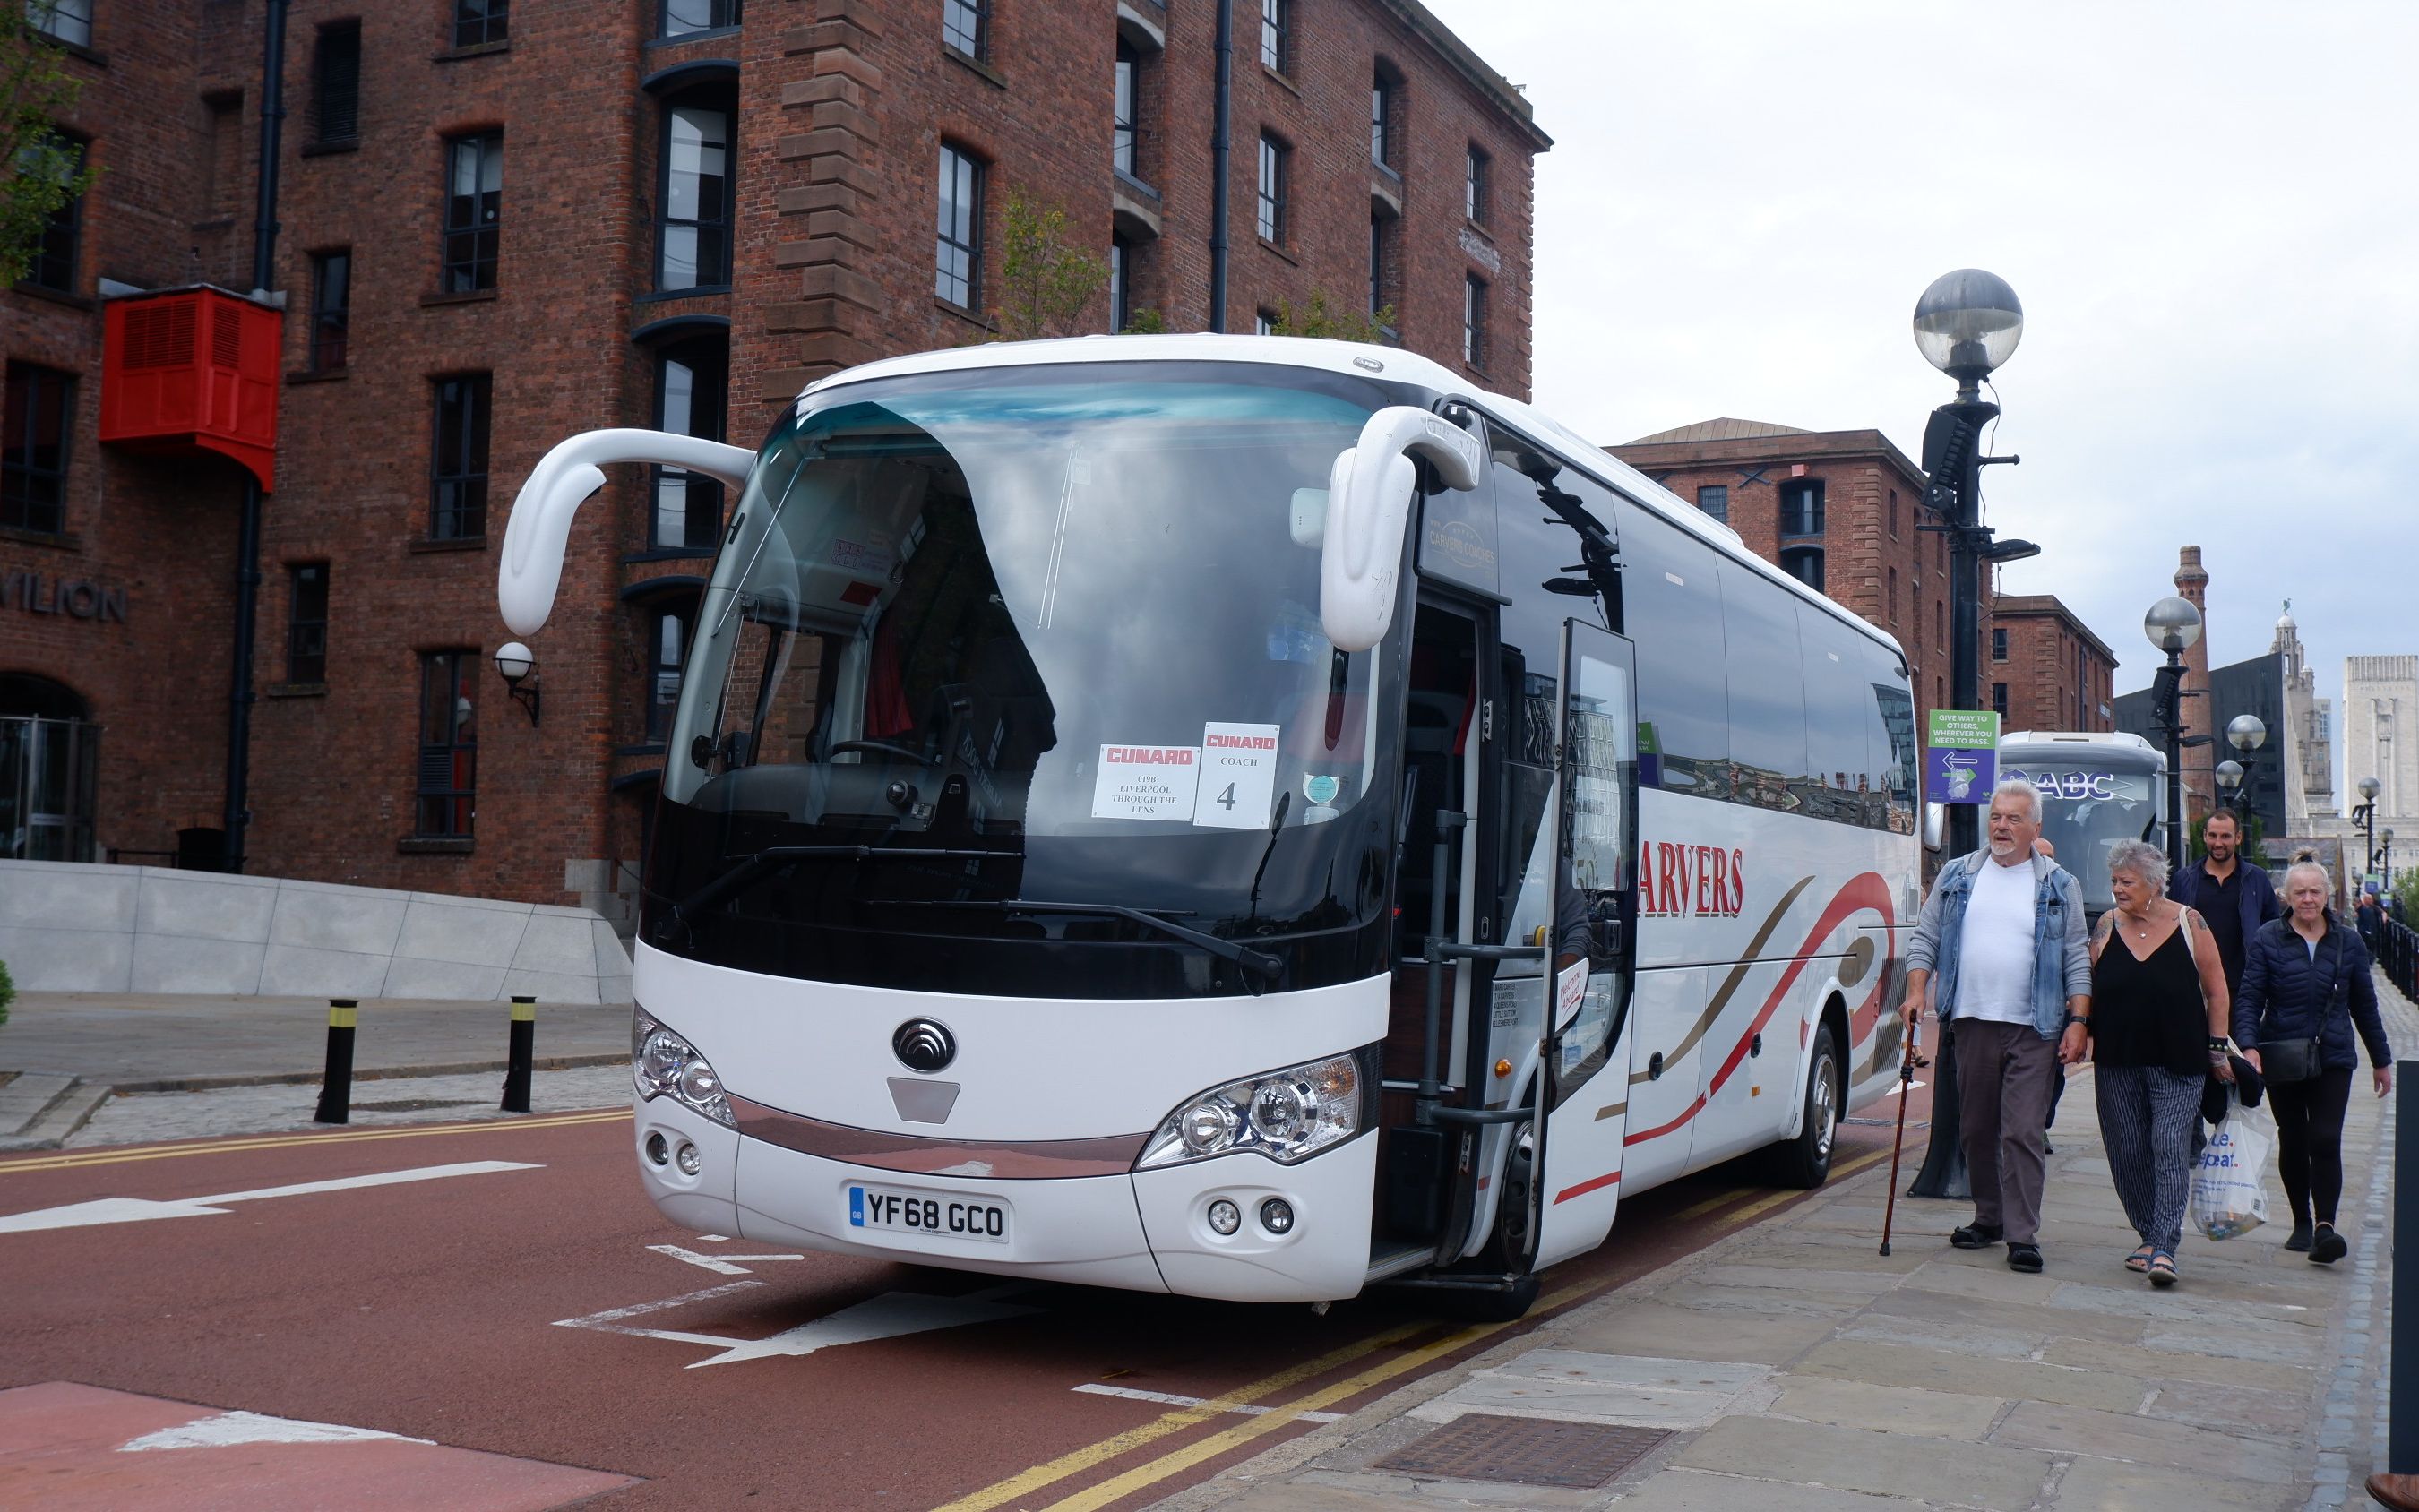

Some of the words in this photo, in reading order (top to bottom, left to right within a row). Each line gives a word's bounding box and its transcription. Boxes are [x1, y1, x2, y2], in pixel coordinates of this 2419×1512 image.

[1429, 530, 1463, 554] CARVERS
[1939, 714, 1958, 722] GIVE
[1958, 715, 1976, 723] WAY
[1976, 715, 1988, 723] TO
[1946, 722, 1979, 730] OTHERS,
[1207, 735, 1277, 750] CUNARD
[1968, 737, 1990, 745] PASS.
[1106, 747, 1193, 766] CUNARD
[1220, 757, 1258, 768] COACH
[1137, 775, 1157, 784] 019B
[1119, 785, 1172, 795] LIVERPOOL
[2036, 771, 2114, 800] ABC
[1111, 795, 1158, 804] THROUGH
[1159, 795, 1177, 804] THE
[1216, 781, 1235, 811] 4
[1131, 805, 1155, 814] LENS
[1615, 840, 1744, 919] ARVERS
[852, 1211, 862, 1220] GB
[868, 1193, 939, 1229] YF68
[948, 1203, 1003, 1236] GCO
